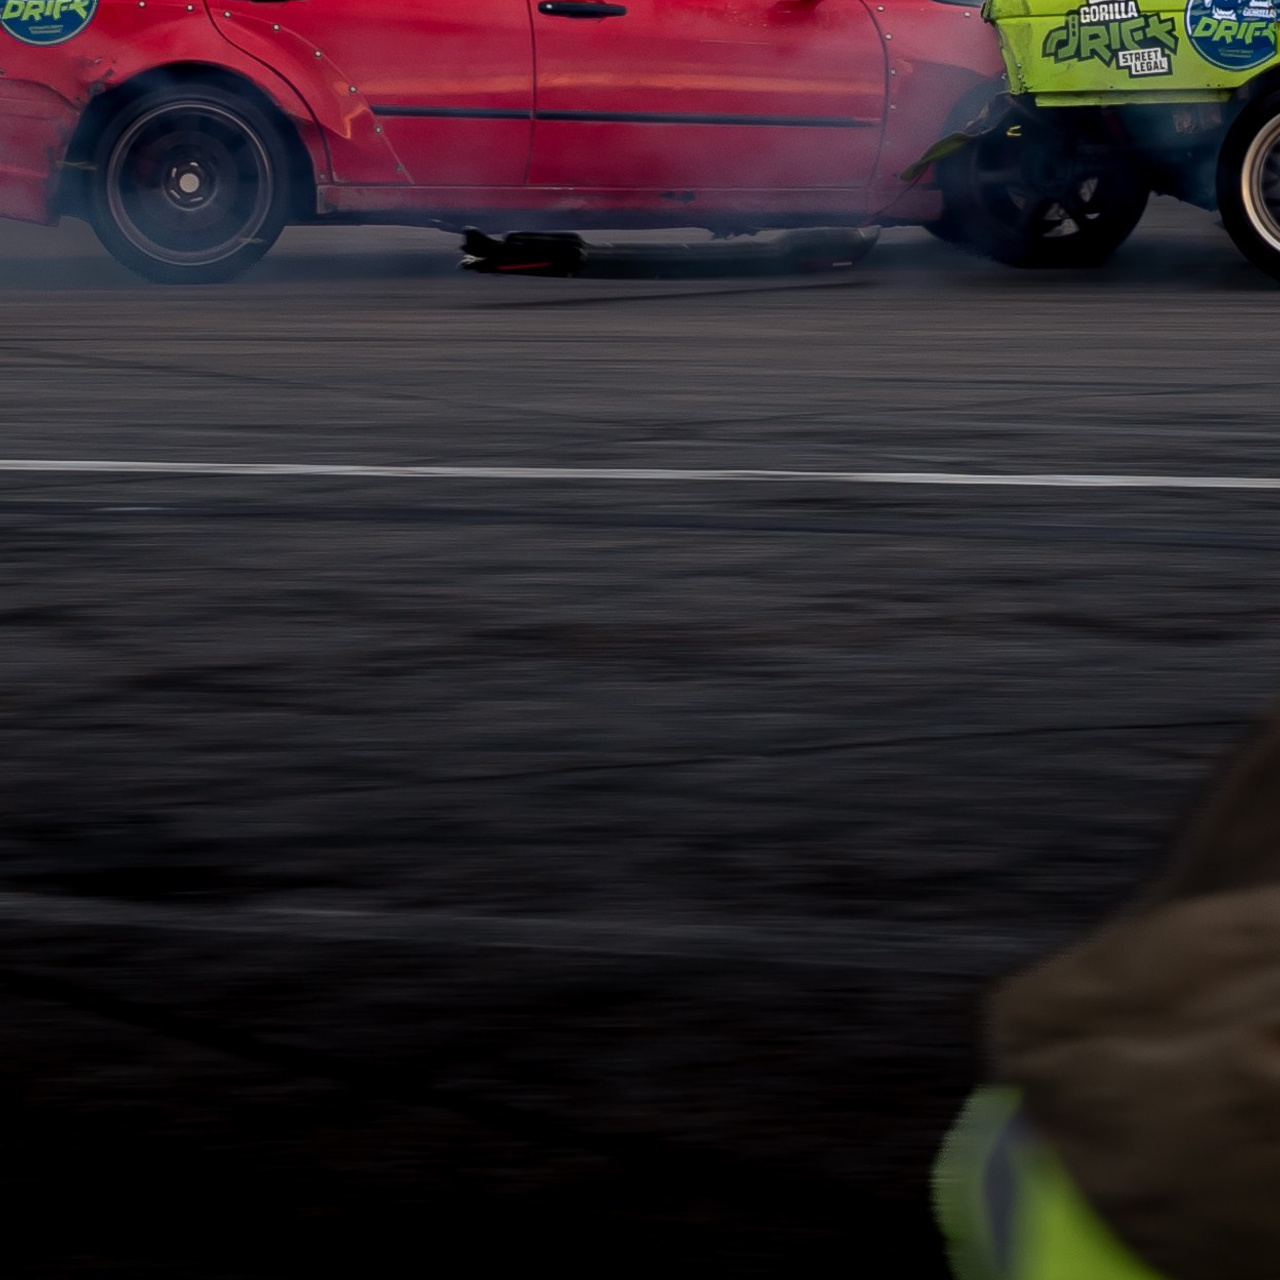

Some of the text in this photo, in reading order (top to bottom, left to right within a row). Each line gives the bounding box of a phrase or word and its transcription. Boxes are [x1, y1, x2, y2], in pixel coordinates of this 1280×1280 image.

[1080, 1, 1139, 23] GORILLA
[1045, 12, 1178, 66] DRIFT
[1122, 50, 1160, 64] STREET
[1134, 60, 1168, 73] LEGAL
